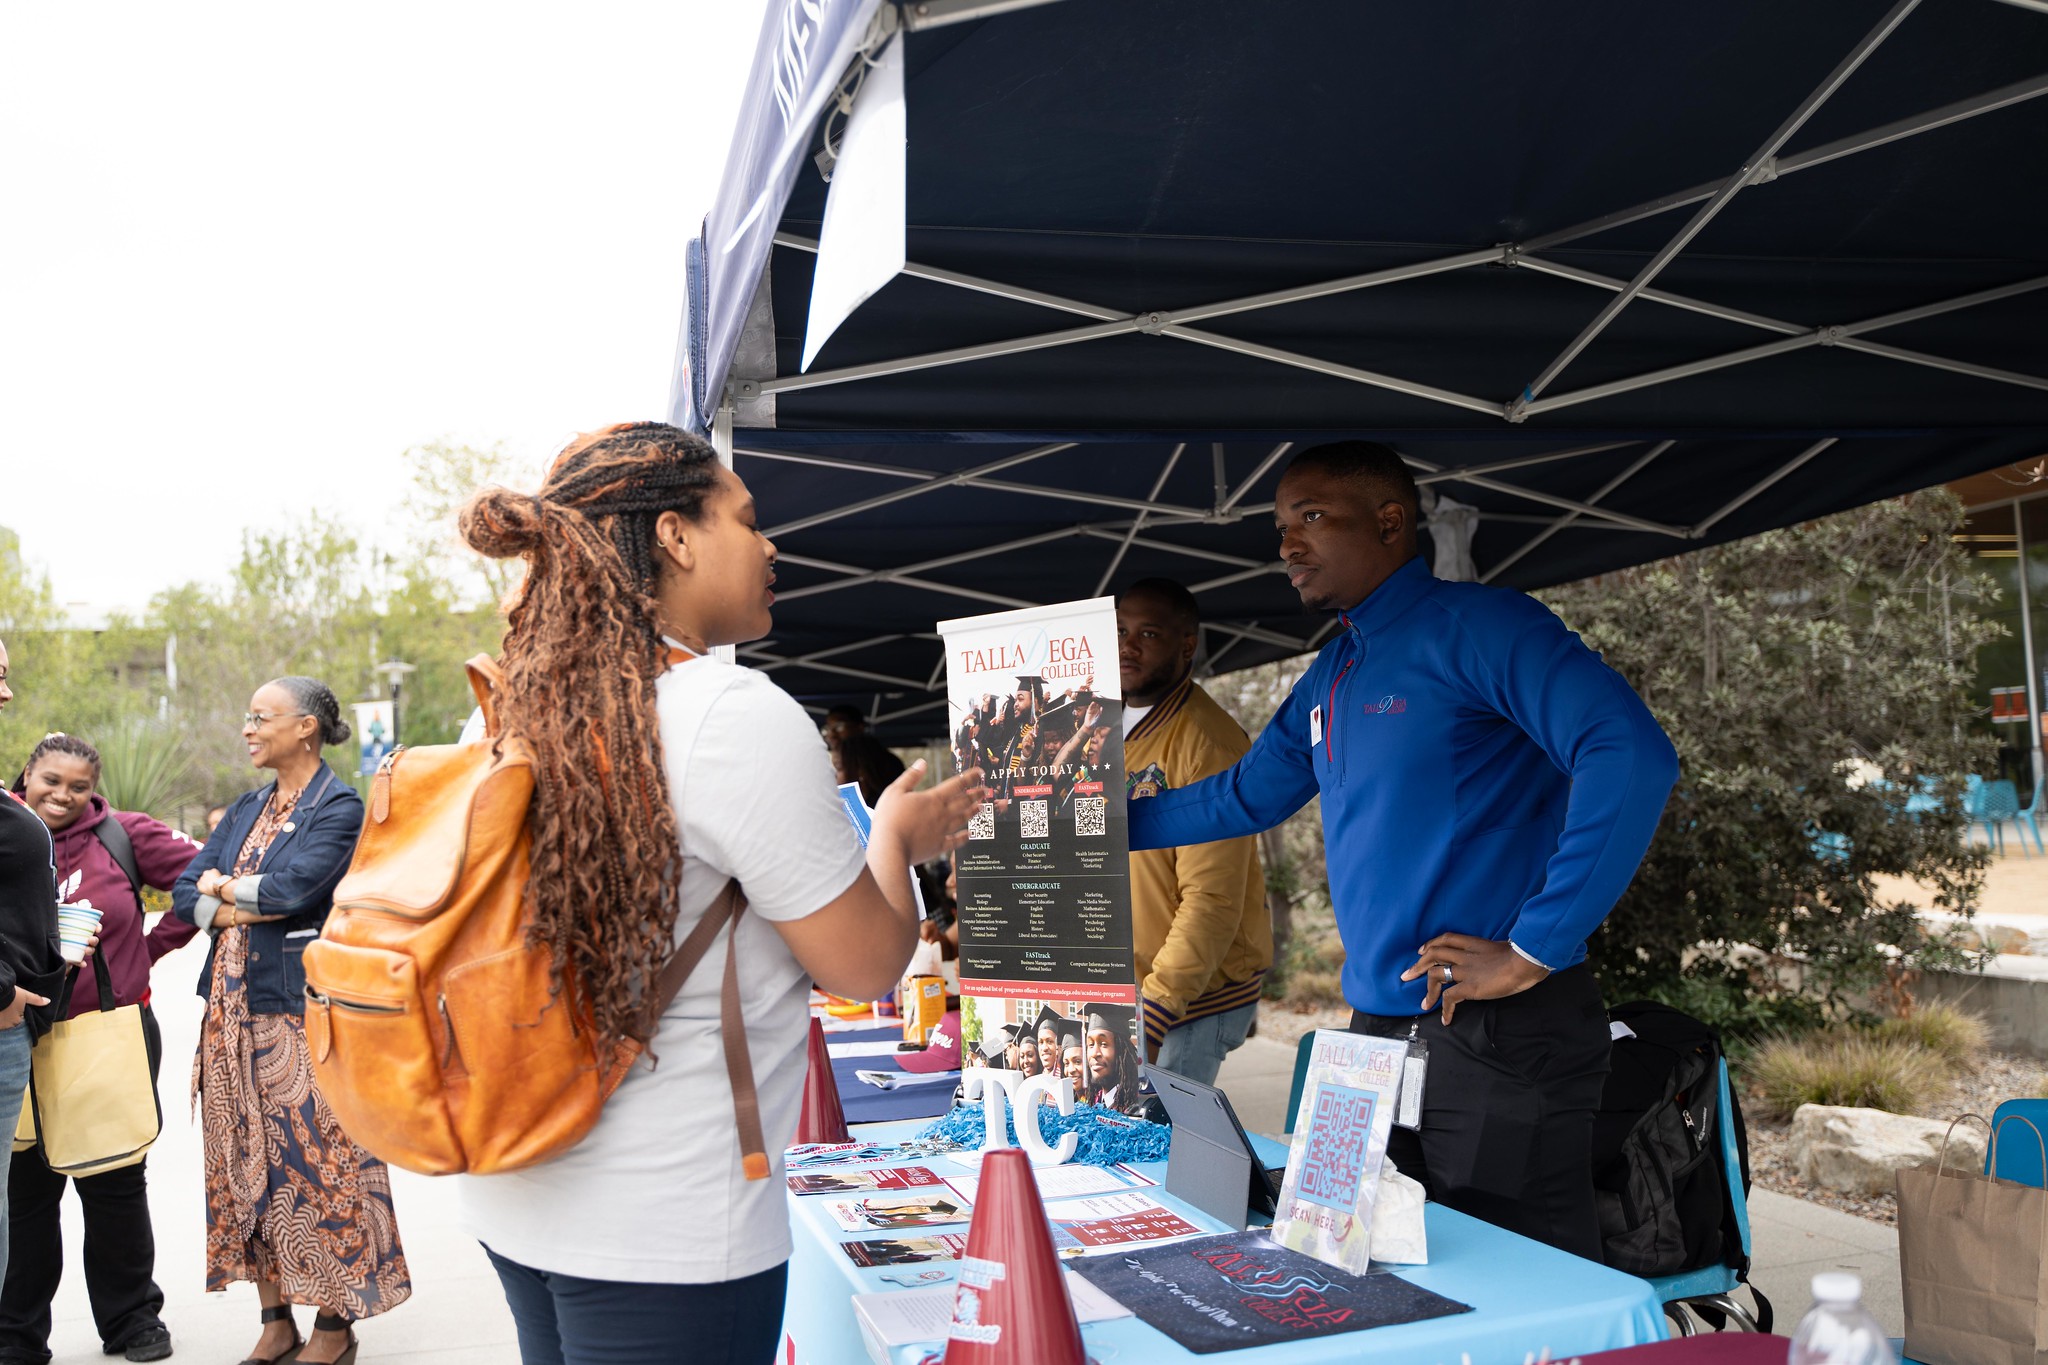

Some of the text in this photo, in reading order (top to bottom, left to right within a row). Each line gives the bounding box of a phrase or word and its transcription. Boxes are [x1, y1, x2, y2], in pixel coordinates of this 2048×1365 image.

[961, 624, 1094, 675] TALLADEGA
[1041, 661, 1095, 680] COLLEGE
[990, 763, 1074, 780] APPLY TODAY
[1020, 842, 1051, 850] GRADUATE
[1012, 882, 1061, 890] UNDERGRADUATE
[1025, 951, 1051, 959] FASTtrack
[1318, 1040, 1393, 1073] TALLADEGA
[1359, 1071, 1390, 1087] COLLEGE
[962, 1067, 1078, 1164] TC
[1289, 1205, 1335, 1232] SCAN HERE
